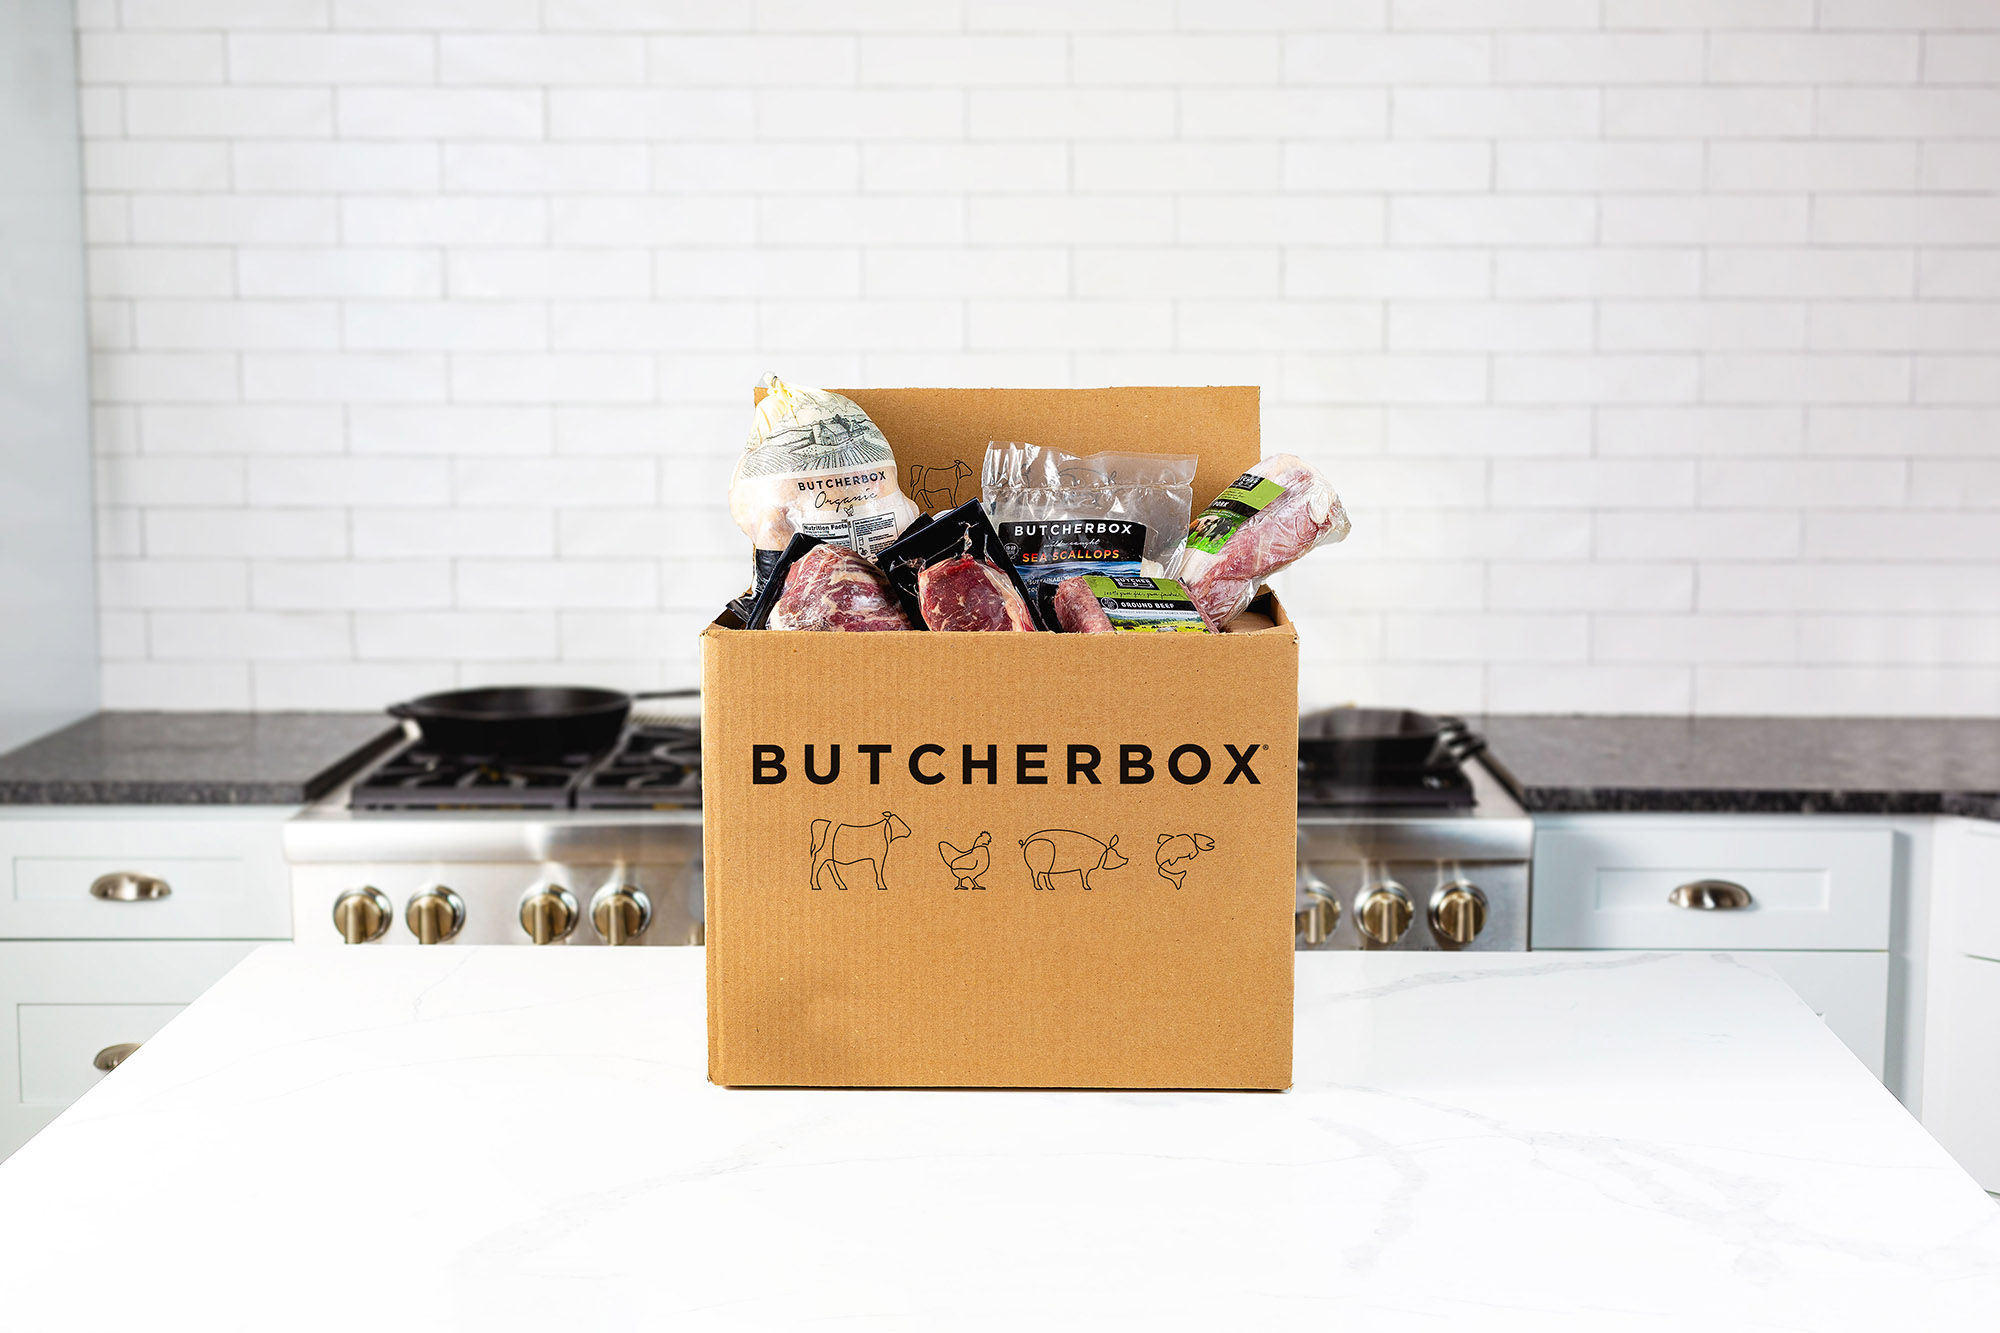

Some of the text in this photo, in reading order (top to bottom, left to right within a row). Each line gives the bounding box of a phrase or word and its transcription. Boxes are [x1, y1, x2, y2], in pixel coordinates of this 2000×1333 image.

[798, 471, 887, 491] BUTCHERBOX
[814, 487, 878, 513] Organic
[1014, 523, 1133, 537] BUTCHERBOX
[1022, 549, 1120, 563] SEA SCALLOPS
[1120, 601, 1153, 609] GROUND
[1155, 601, 1175, 609] BEEF
